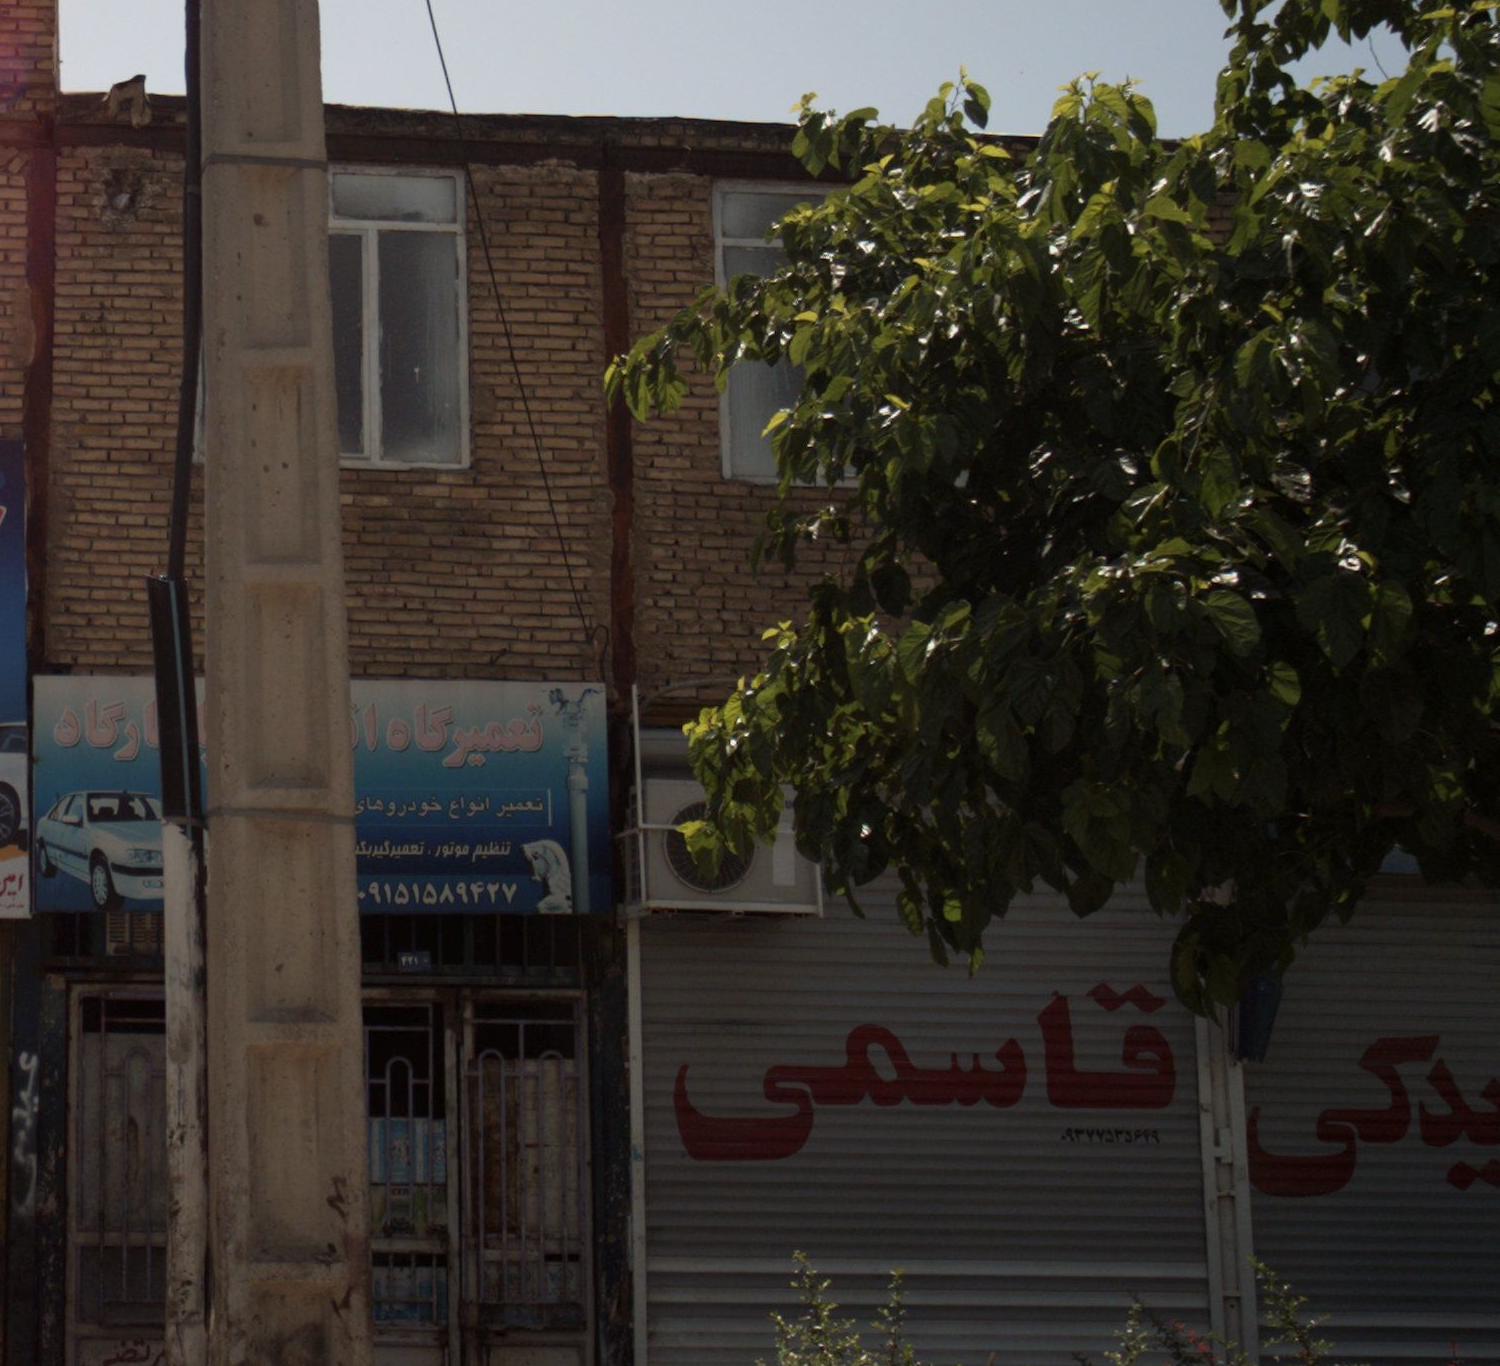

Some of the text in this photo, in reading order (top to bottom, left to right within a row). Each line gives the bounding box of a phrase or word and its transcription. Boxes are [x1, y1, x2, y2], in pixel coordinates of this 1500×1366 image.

[387, 702, 544, 768] تعمیرگاه
[448, 796, 490, 820] انواع
[495, 797, 544, 817] تعمیر
[470, 841, 512, 863] تنظیم
[673, 981, 1177, 1161] قاسمی
